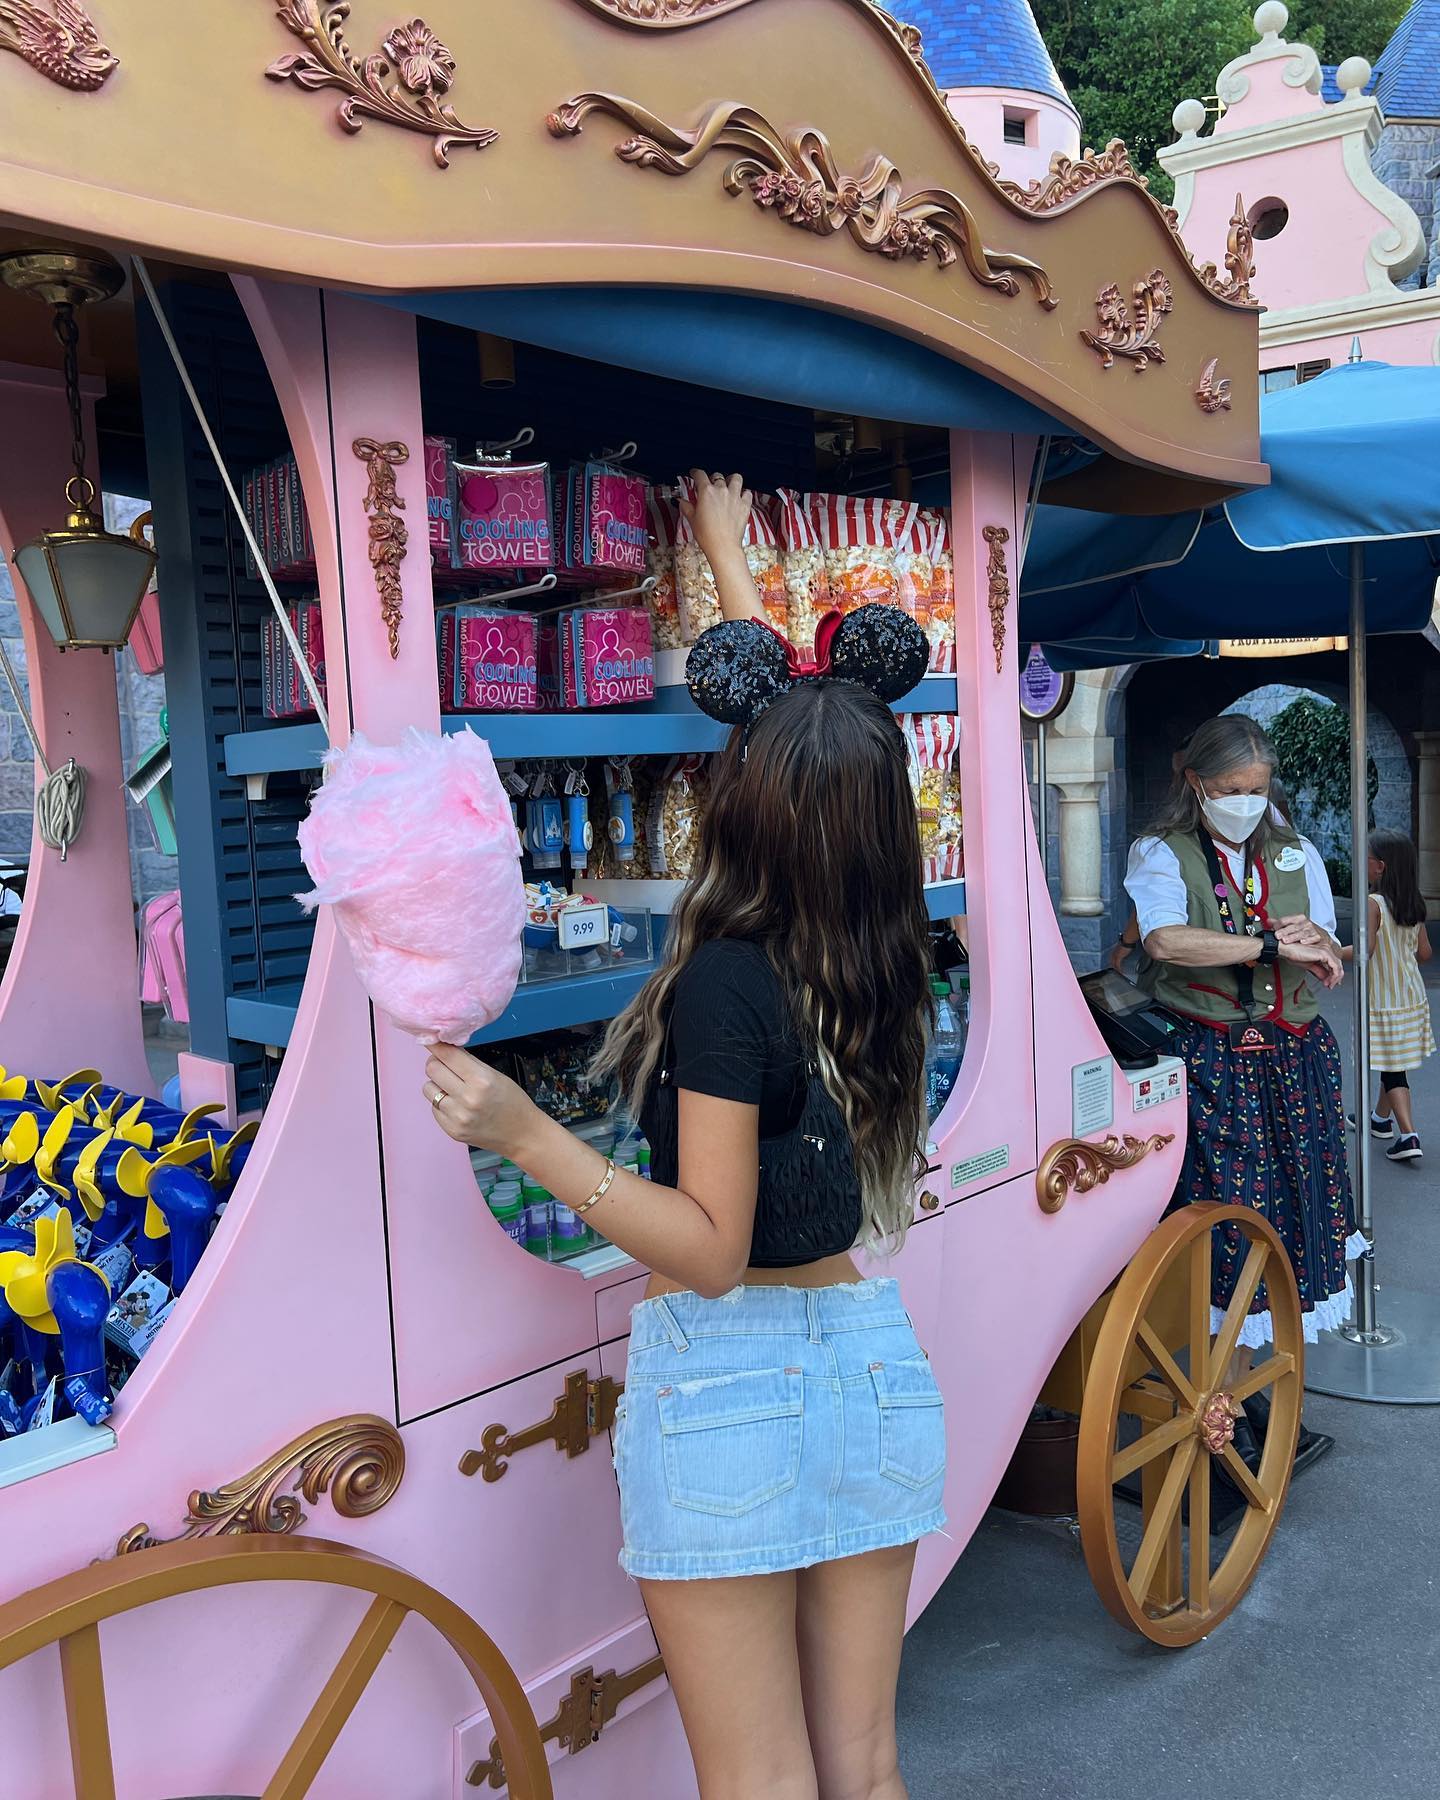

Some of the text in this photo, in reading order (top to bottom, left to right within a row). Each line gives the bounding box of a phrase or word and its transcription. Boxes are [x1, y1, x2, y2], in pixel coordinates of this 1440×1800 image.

[573, 474, 583, 560] COOLING TOWEL
[591, 471, 601, 556] COOLING TOWEL
[461, 519, 549, 539] COOLING
[462, 542, 549, 561] TOWEL
[607, 540, 647, 568] TOWEL
[441, 619, 449, 650] TOWEL
[460, 615, 468, 646] TOWEL
[474, 662, 537, 684] COOLING
[594, 657, 653, 680] COOLING
[476, 684, 536, 704] TOWEL
[596, 679, 654, 697] TOWEL
[573, 921, 594, 936] 9.99
[115, 1317, 137, 1336] MISTIN
